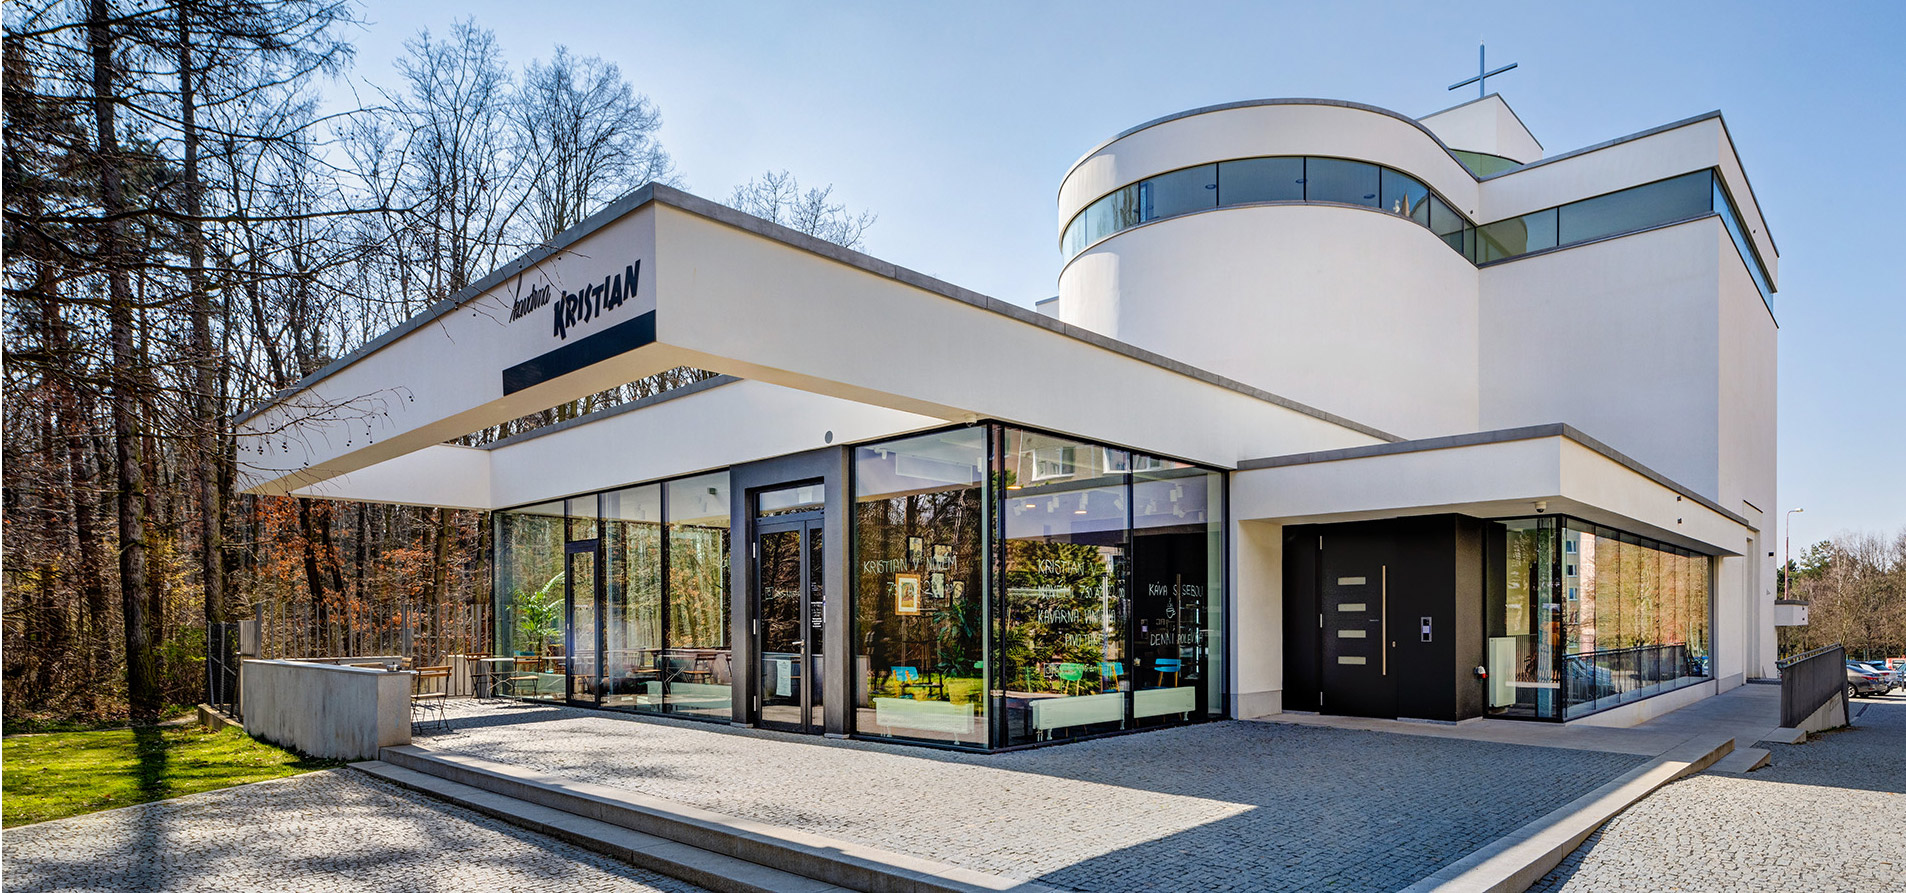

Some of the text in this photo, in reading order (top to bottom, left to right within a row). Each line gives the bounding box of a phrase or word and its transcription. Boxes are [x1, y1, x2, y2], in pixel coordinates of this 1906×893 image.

[553, 259, 641, 340] KRISTIAN
[863, 558, 908, 575] KRISTIAN
[912, 558, 920, 571] V
[1038, 558, 1084, 575] KRISTIAN
[1148, 581, 1168, 596] KÁVA
[1038, 606, 1080, 624] KAVÁRNA
[1150, 627, 1175, 646] DENNÍ
